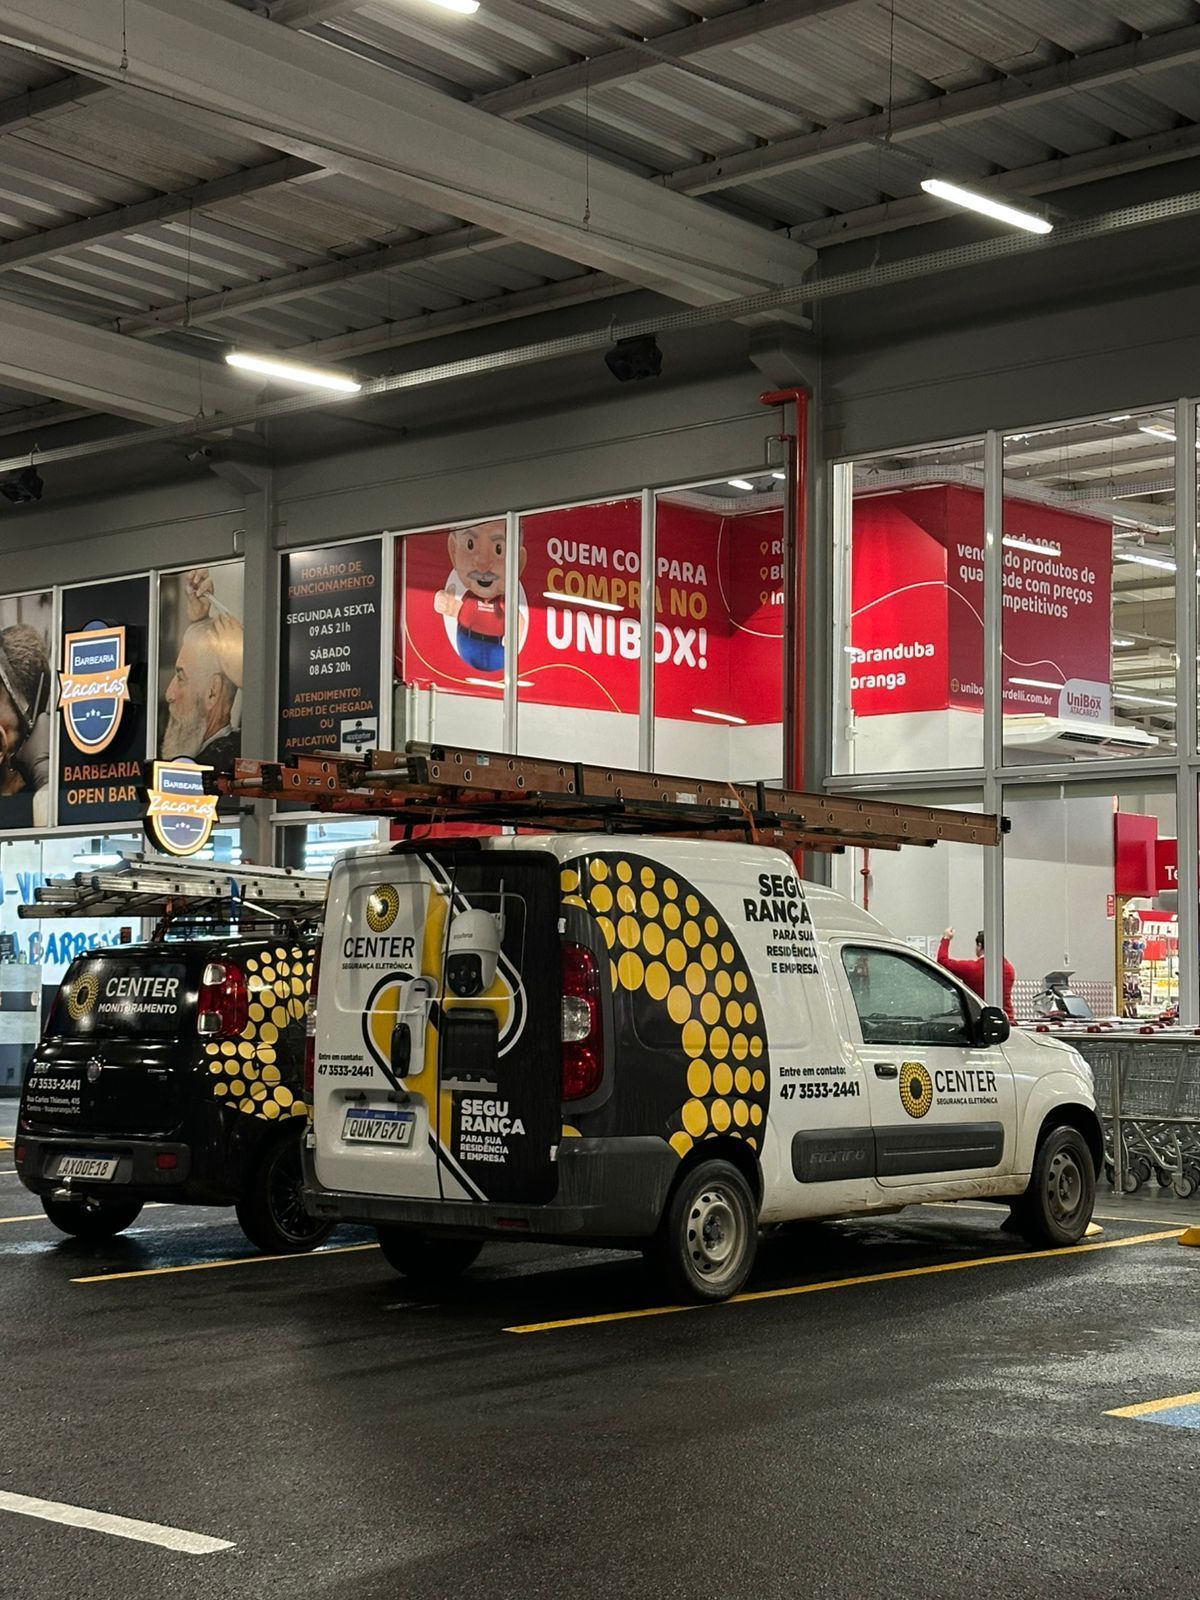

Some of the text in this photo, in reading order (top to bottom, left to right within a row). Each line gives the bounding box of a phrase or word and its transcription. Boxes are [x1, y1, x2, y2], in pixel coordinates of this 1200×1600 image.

[302, 561, 361, 579] HORÁRIO DE
[547, 537, 707, 586] QUEM COPARA
[1023, 557, 1078, 581] produtos
[1081, 567, 1095, 584] de
[288, 574, 375, 596] FUNCIONAMENTO
[1025, 579, 1050, 595] com
[1053, 583, 1093, 605] preços
[287, 603, 375, 624] SEGUNDA A SEXTA
[670, 588, 707, 620] NO
[1002, 593, 1068, 619] mpetitivos
[309, 626, 319, 636] 09
[546, 606, 707, 670] UNIBOX!
[310, 646, 350, 660] SÁBADO
[309, 665, 319, 675] 08
[336, 661, 351, 673] 20h
[61, 675, 127, 699] Zacarias
[282, 701, 373, 718] ORDEM DE CHEGADA
[1067, 692, 1101, 710] UniBox
[320, 719, 334, 728] OU
[286, 734, 337, 747] APLICATIVO
[64, 761, 141, 782] BARBEARIA
[67, 786, 136, 805] OPEN BAR
[151, 796, 214, 818] Zacarias
[758, 873, 805, 899] SEGU
[743, 898, 812, 928] RANÇA
[773, 929, 814, 941] PARA SUA
[343, 937, 416, 958] CENTER
[766, 943, 818, 958] RESIDÊNCIA
[771, 962, 819, 975] E EMPRESA
[105, 977, 179, 998] CENTER
[98, 1003, 177, 1014] MONITORAMENTO
[318, 1065, 373, 1077] 47 3533-2441
[779, 1065, 846, 1077] Entre em contato:
[28, 1078, 81, 1090] 47 3533-2441
[780, 1081, 860, 1100] 47 3533-2441
[934, 1070, 998, 1093] CENTER
[461, 1098, 509, 1117] SEGU
[461, 1115, 526, 1137] RANÇA
[460, 1134, 502, 1145] PARA SUA
[460, 1152, 506, 1163] E EMPRESA
